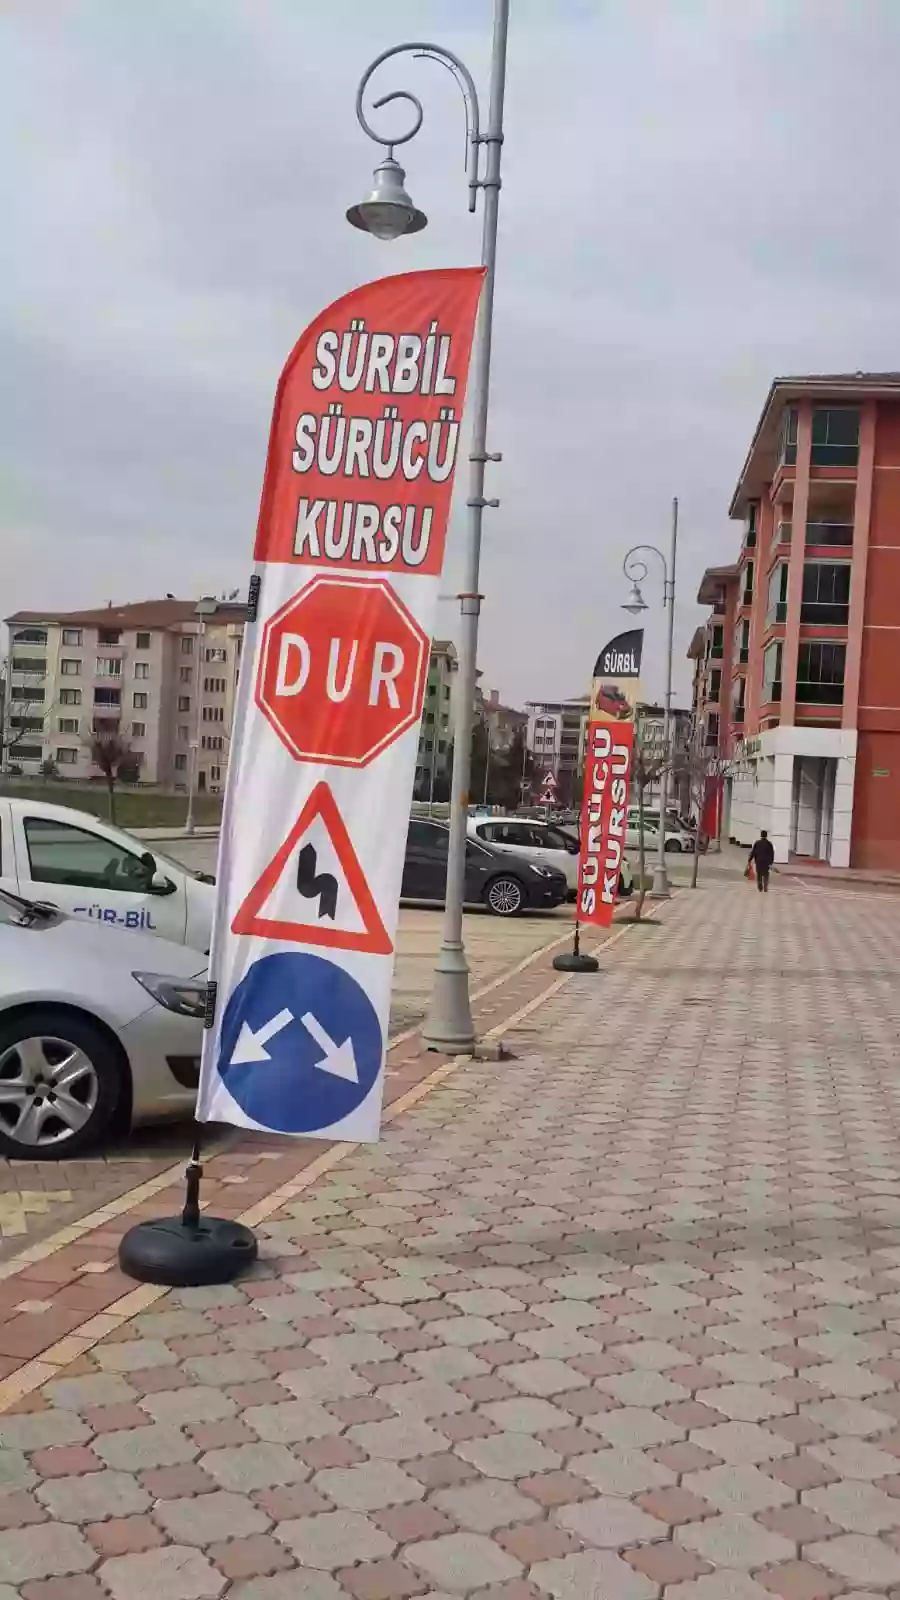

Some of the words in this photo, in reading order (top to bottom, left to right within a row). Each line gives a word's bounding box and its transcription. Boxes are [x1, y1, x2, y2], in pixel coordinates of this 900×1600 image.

[311, 318, 457, 396] SÜRBİL
[291, 403, 460, 482] SÜRÜCÜ
[292, 496, 434, 566] KURSU
[275, 632, 405, 709] DUR
[601, 745, 629, 904] KURSU
[73, 903, 157, 930] ÜR-BİL
